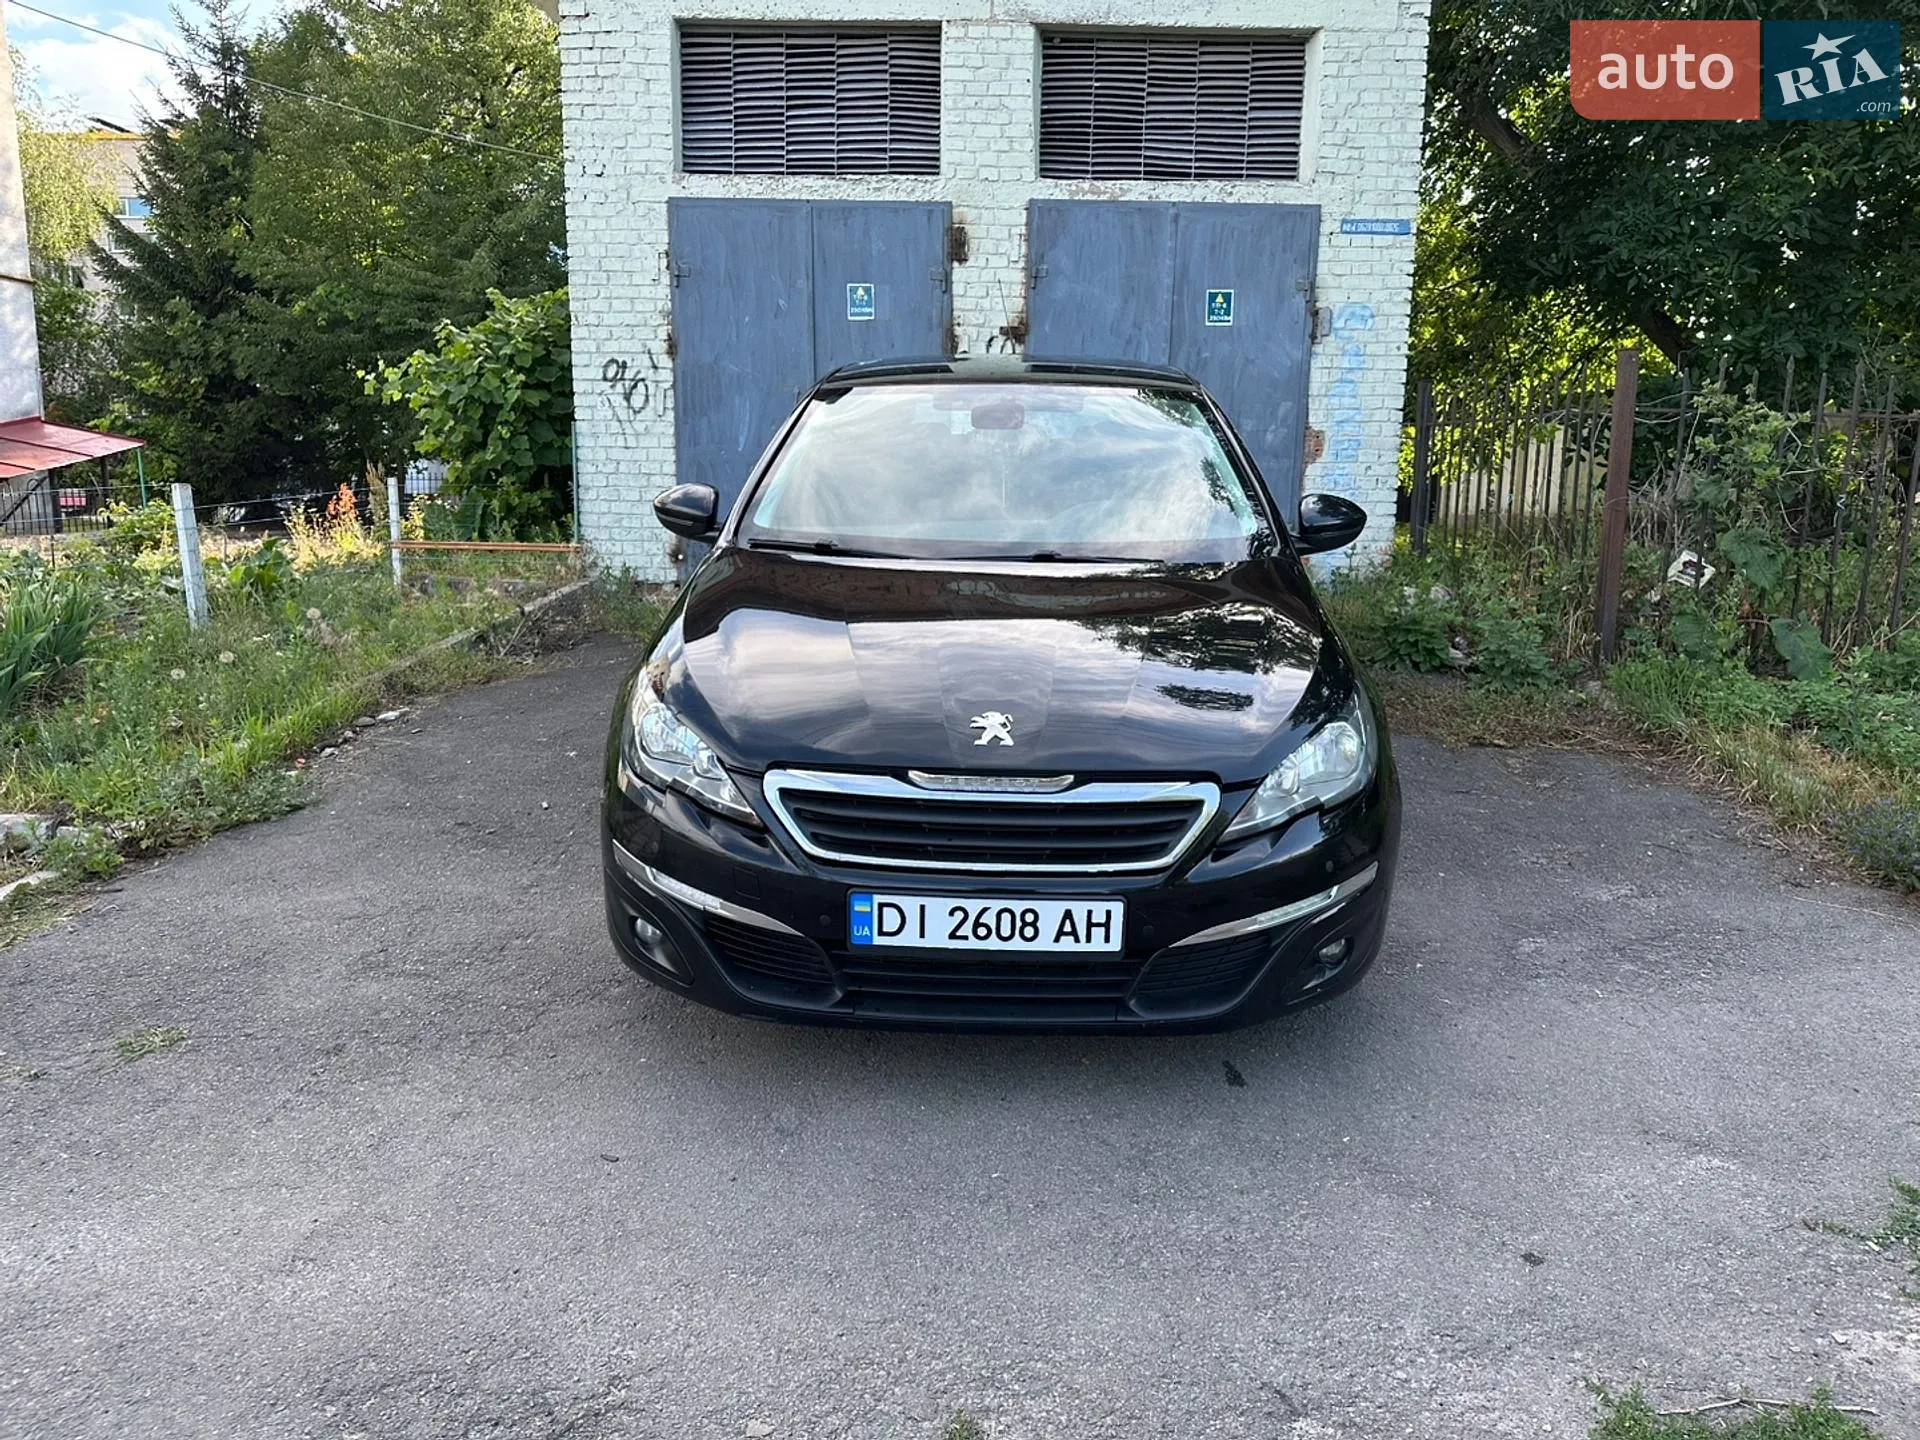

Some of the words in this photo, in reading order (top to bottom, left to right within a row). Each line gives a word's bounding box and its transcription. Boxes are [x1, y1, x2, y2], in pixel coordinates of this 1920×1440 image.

[854, 925, 871, 937] UA
[877, 902, 926, 939] DI
[948, 905, 1040, 943] 2608
[1053, 908, 1112, 944] AH
